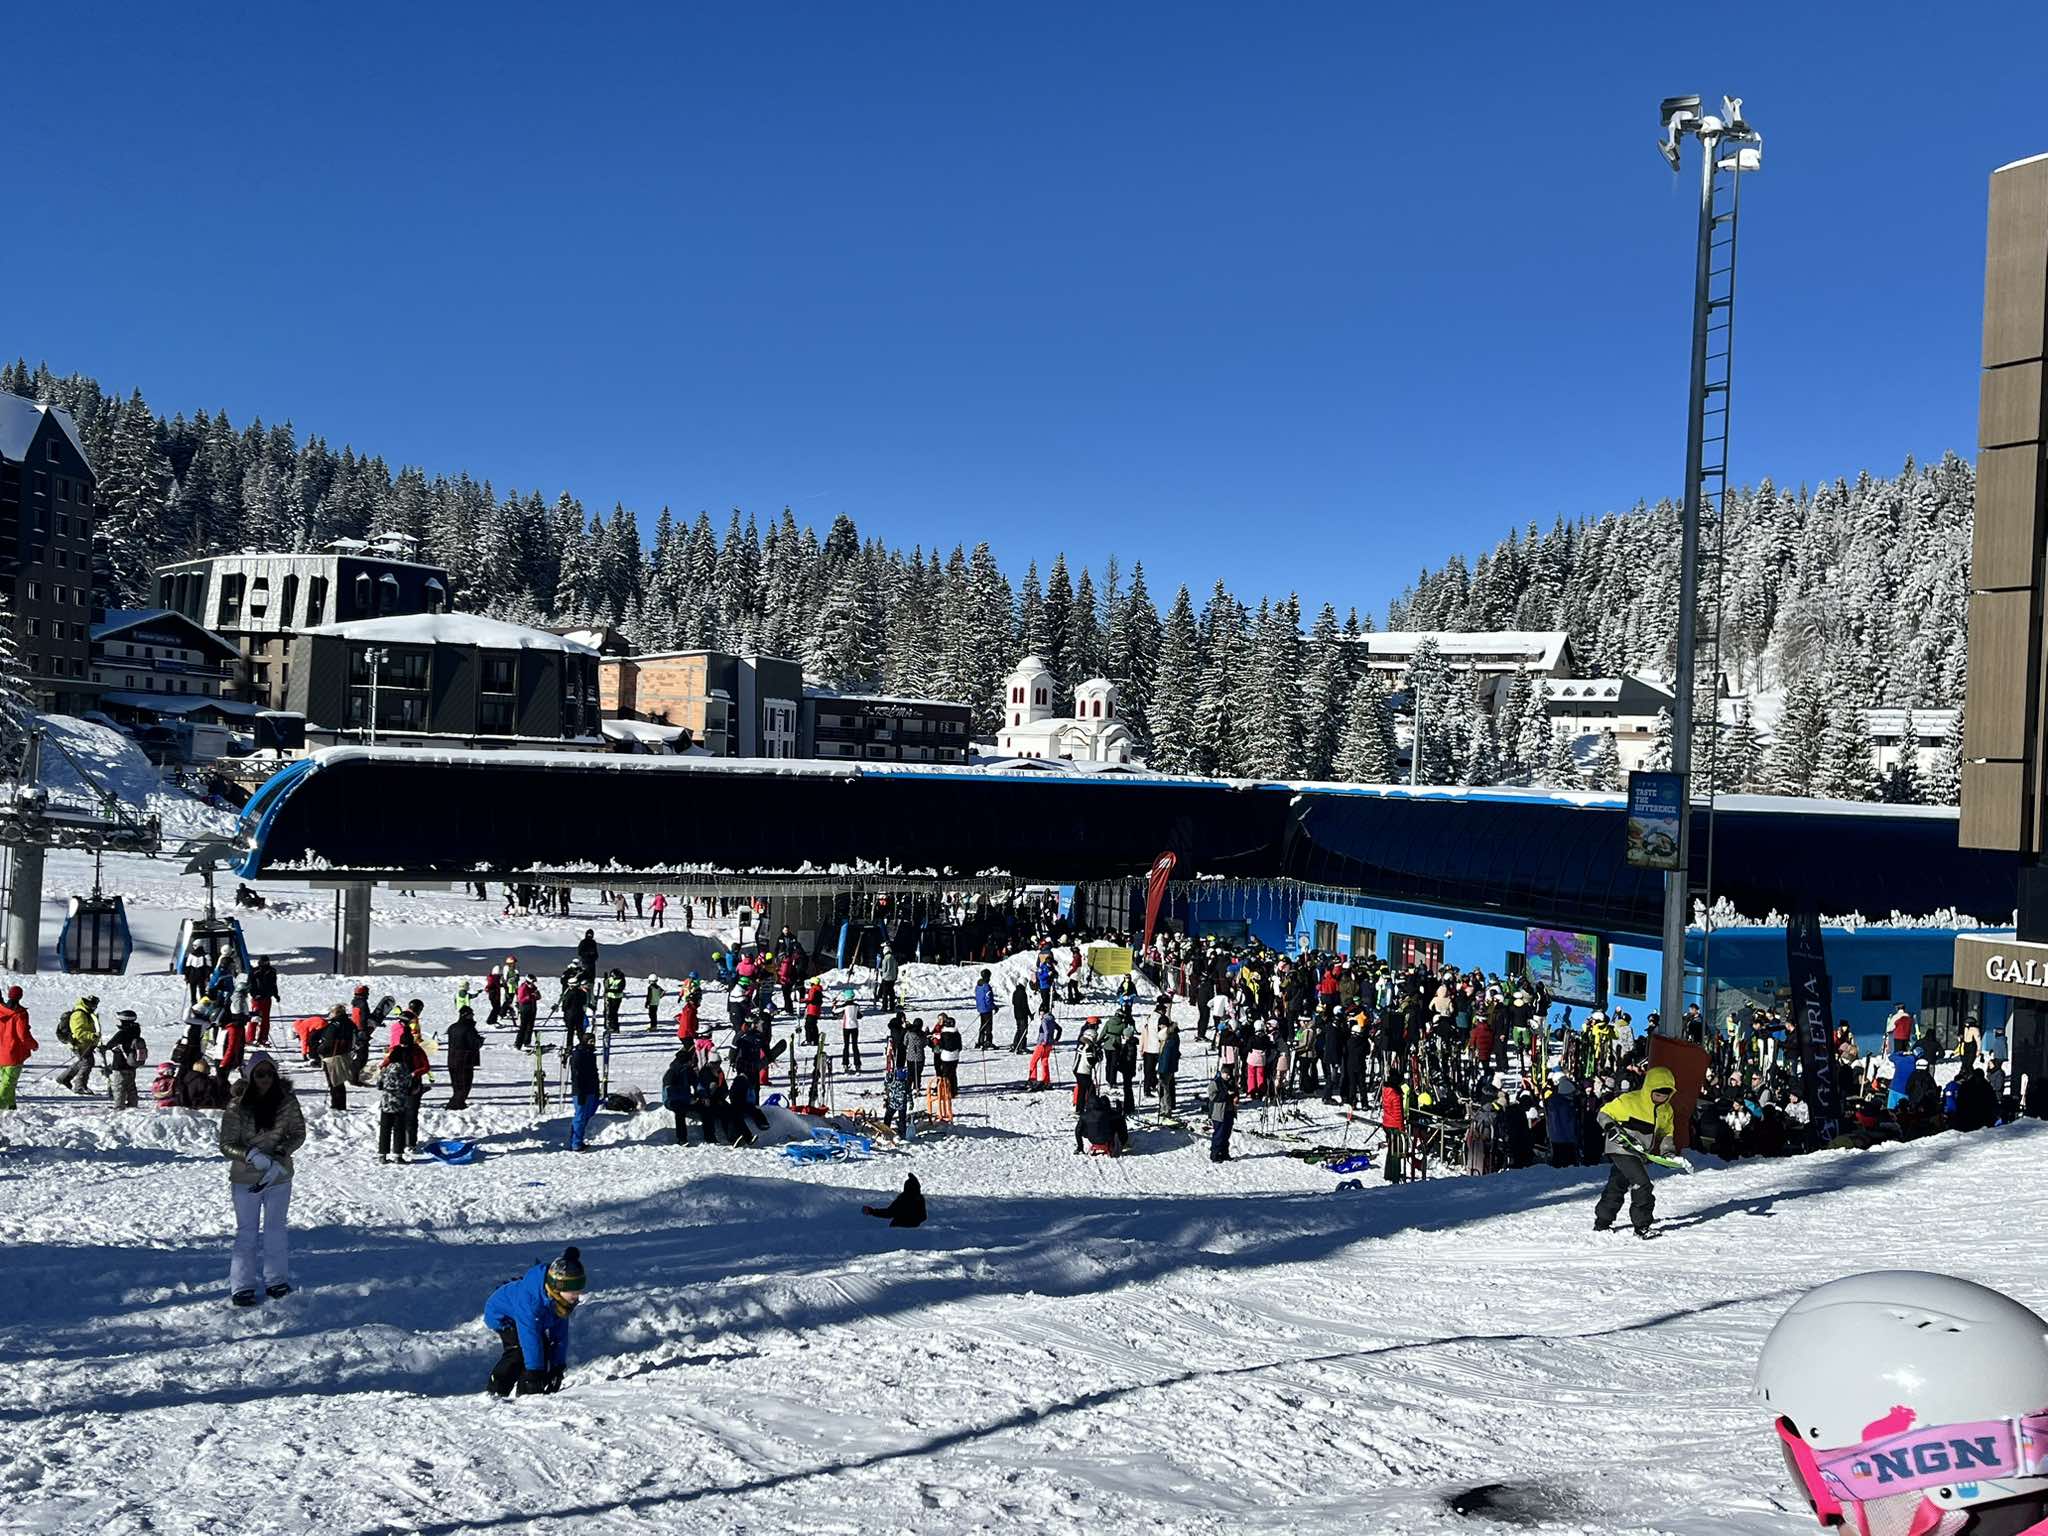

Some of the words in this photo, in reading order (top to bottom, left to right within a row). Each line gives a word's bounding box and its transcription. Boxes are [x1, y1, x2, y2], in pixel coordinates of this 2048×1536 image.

[1635, 788, 1657, 797] TASTE
[1635, 796, 1649, 804] THE
[1634, 804, 1677, 814] DIFFERENCE
[1986, 955, 2048, 988] GAL
[1804, 973, 1831, 1106] GALERIA
[1871, 1436, 2001, 1484] NGN
